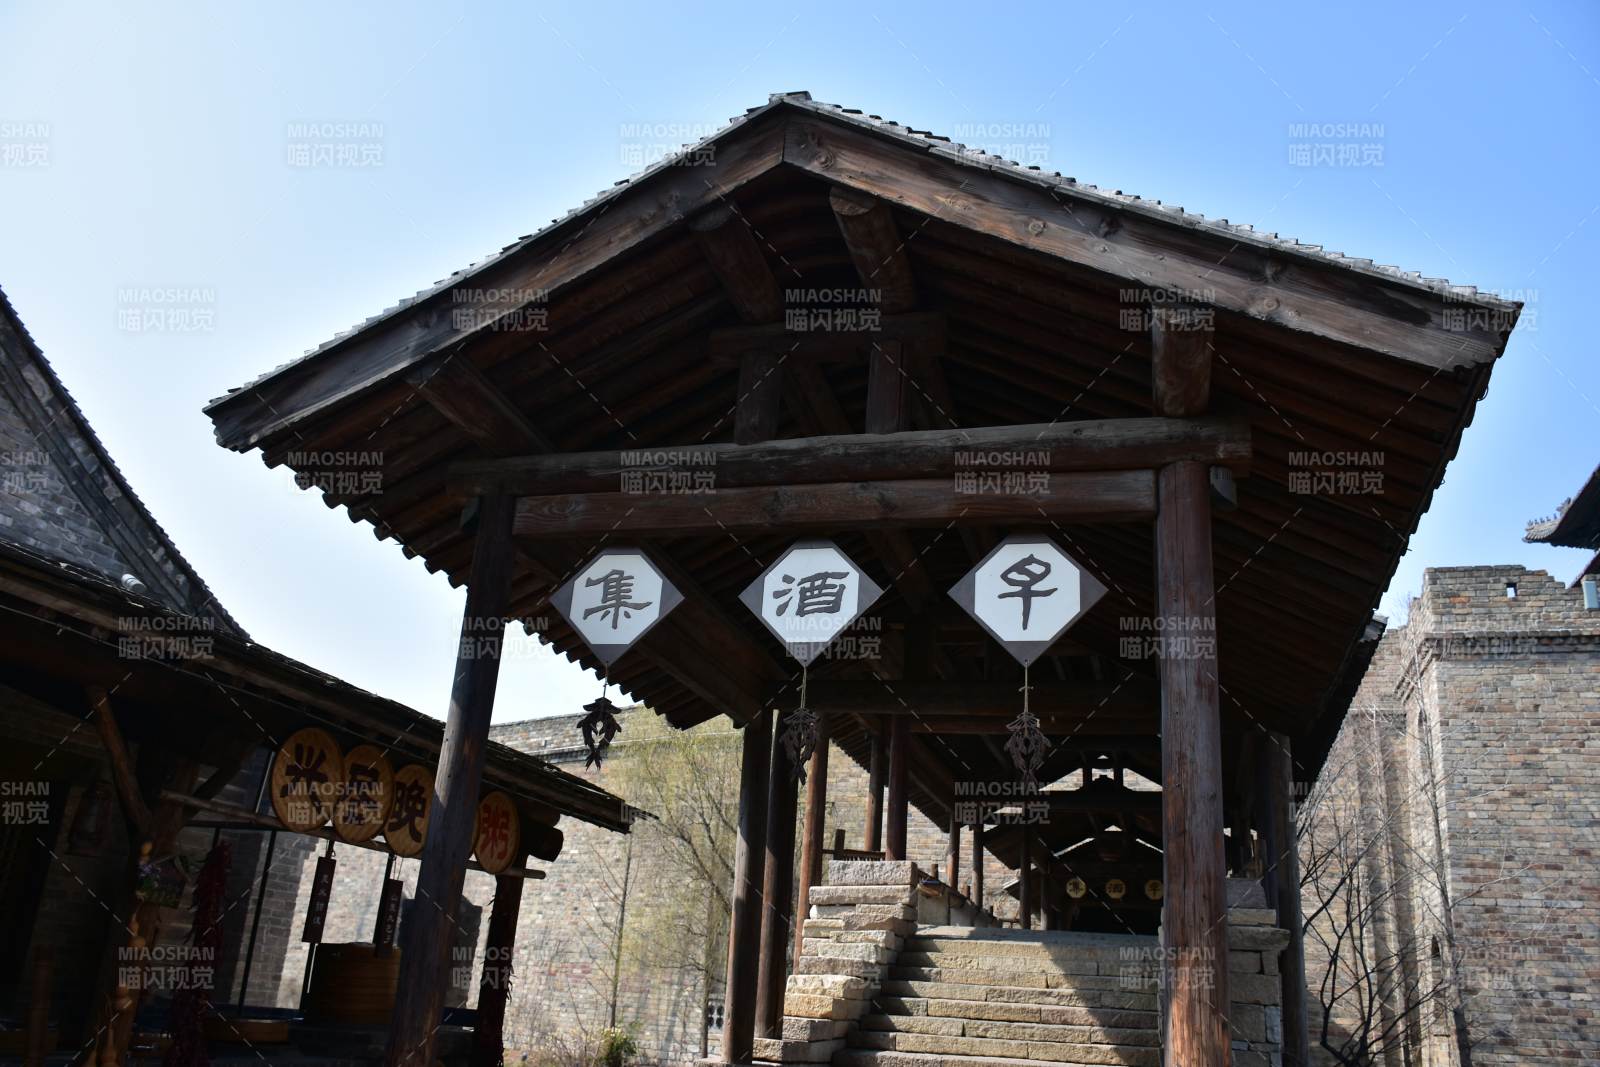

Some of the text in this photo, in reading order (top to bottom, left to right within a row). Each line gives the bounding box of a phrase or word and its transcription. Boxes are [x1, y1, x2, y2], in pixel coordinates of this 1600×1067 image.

[583, 553, 1058, 631] 集 酒 早
